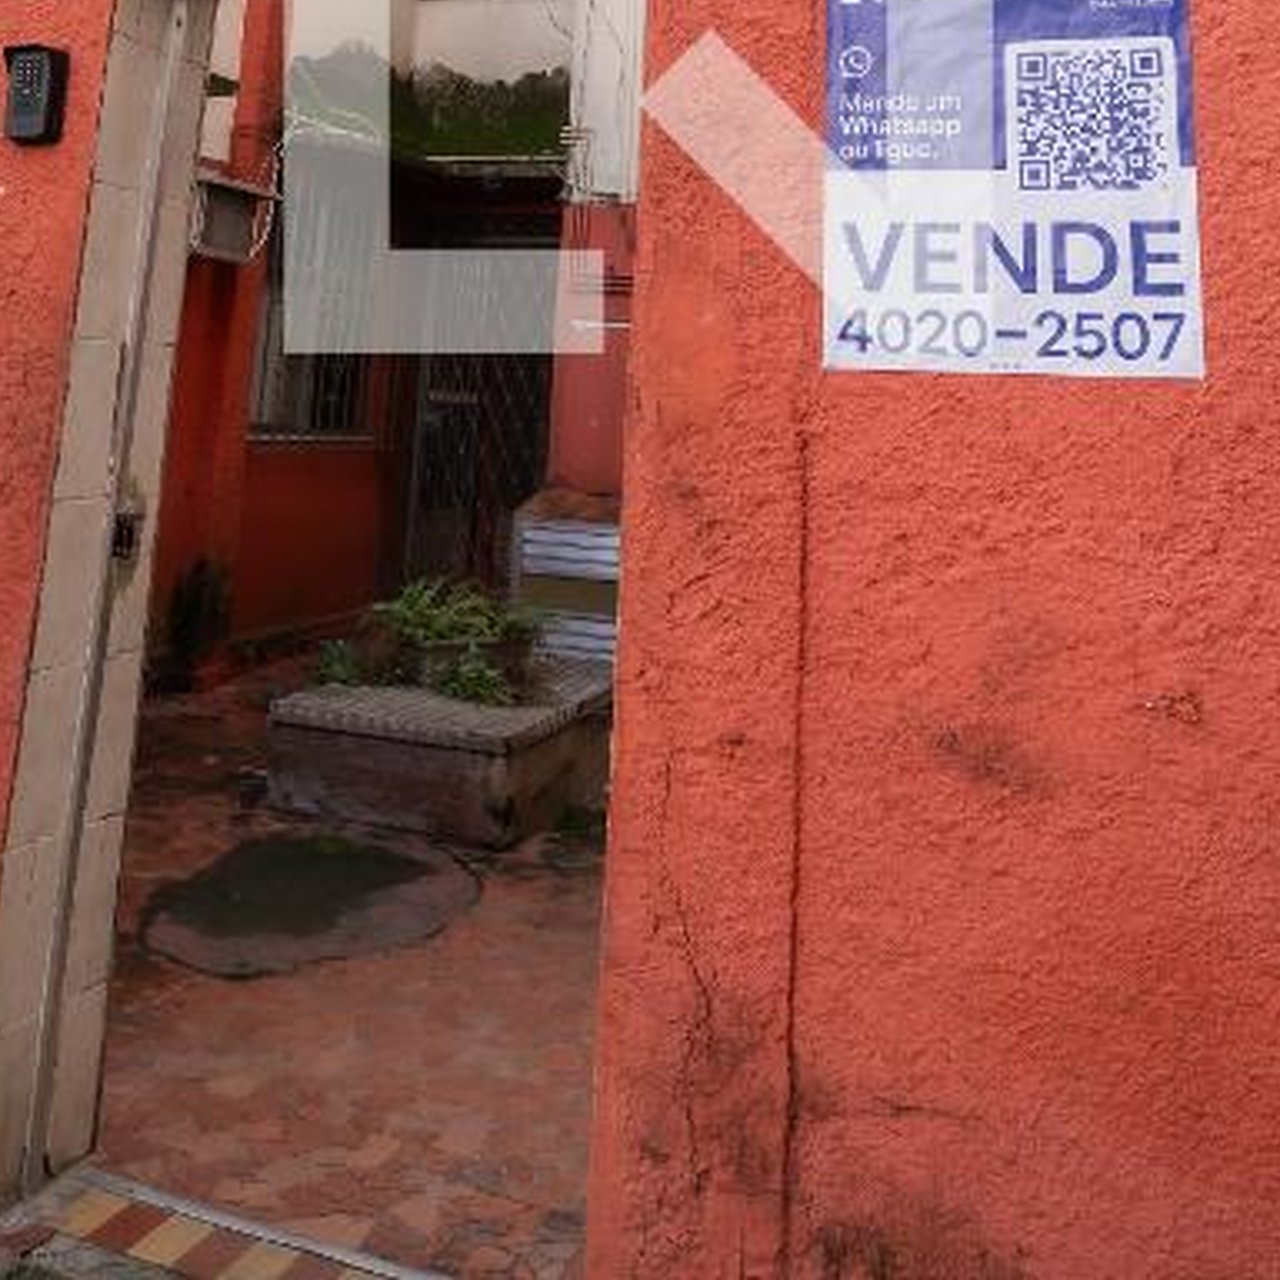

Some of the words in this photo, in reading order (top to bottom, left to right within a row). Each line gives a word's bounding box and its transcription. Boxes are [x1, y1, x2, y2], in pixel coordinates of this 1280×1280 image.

[838, 144, 869, 161] ou
[842, 219, 1186, 297] VENDE
[837, 309, 1186, 361] 4020-2507
